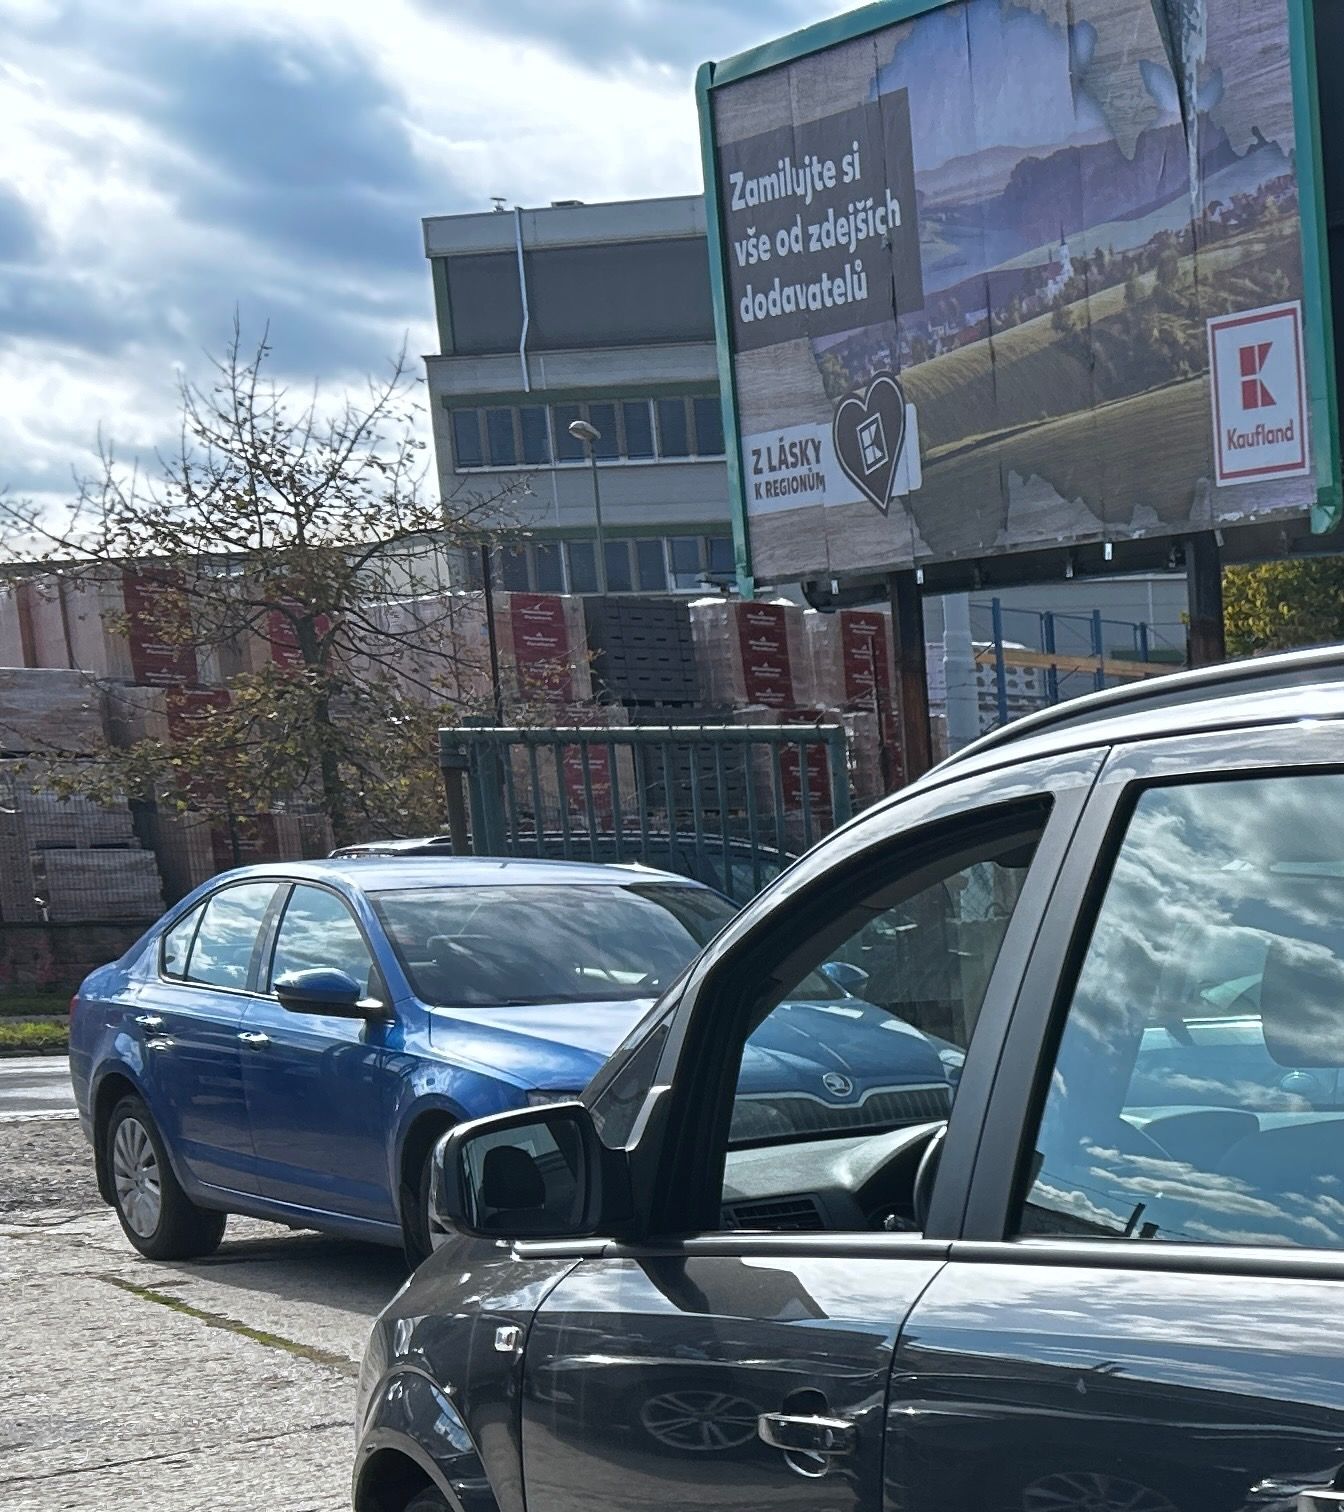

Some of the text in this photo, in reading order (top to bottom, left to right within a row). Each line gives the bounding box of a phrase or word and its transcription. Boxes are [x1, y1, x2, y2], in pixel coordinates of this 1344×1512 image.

[729, 140, 861, 212] Zamilujte si
[734, 188, 902, 267] vše od zdejších
[740, 259, 869, 323] dodavatelů
[1239, 341, 1276, 410] K
[752, 435, 822, 475] Z LÁSKY
[1226, 419, 1295, 451] Kaufland
[754, 467, 826, 500] K REGIONŮM
